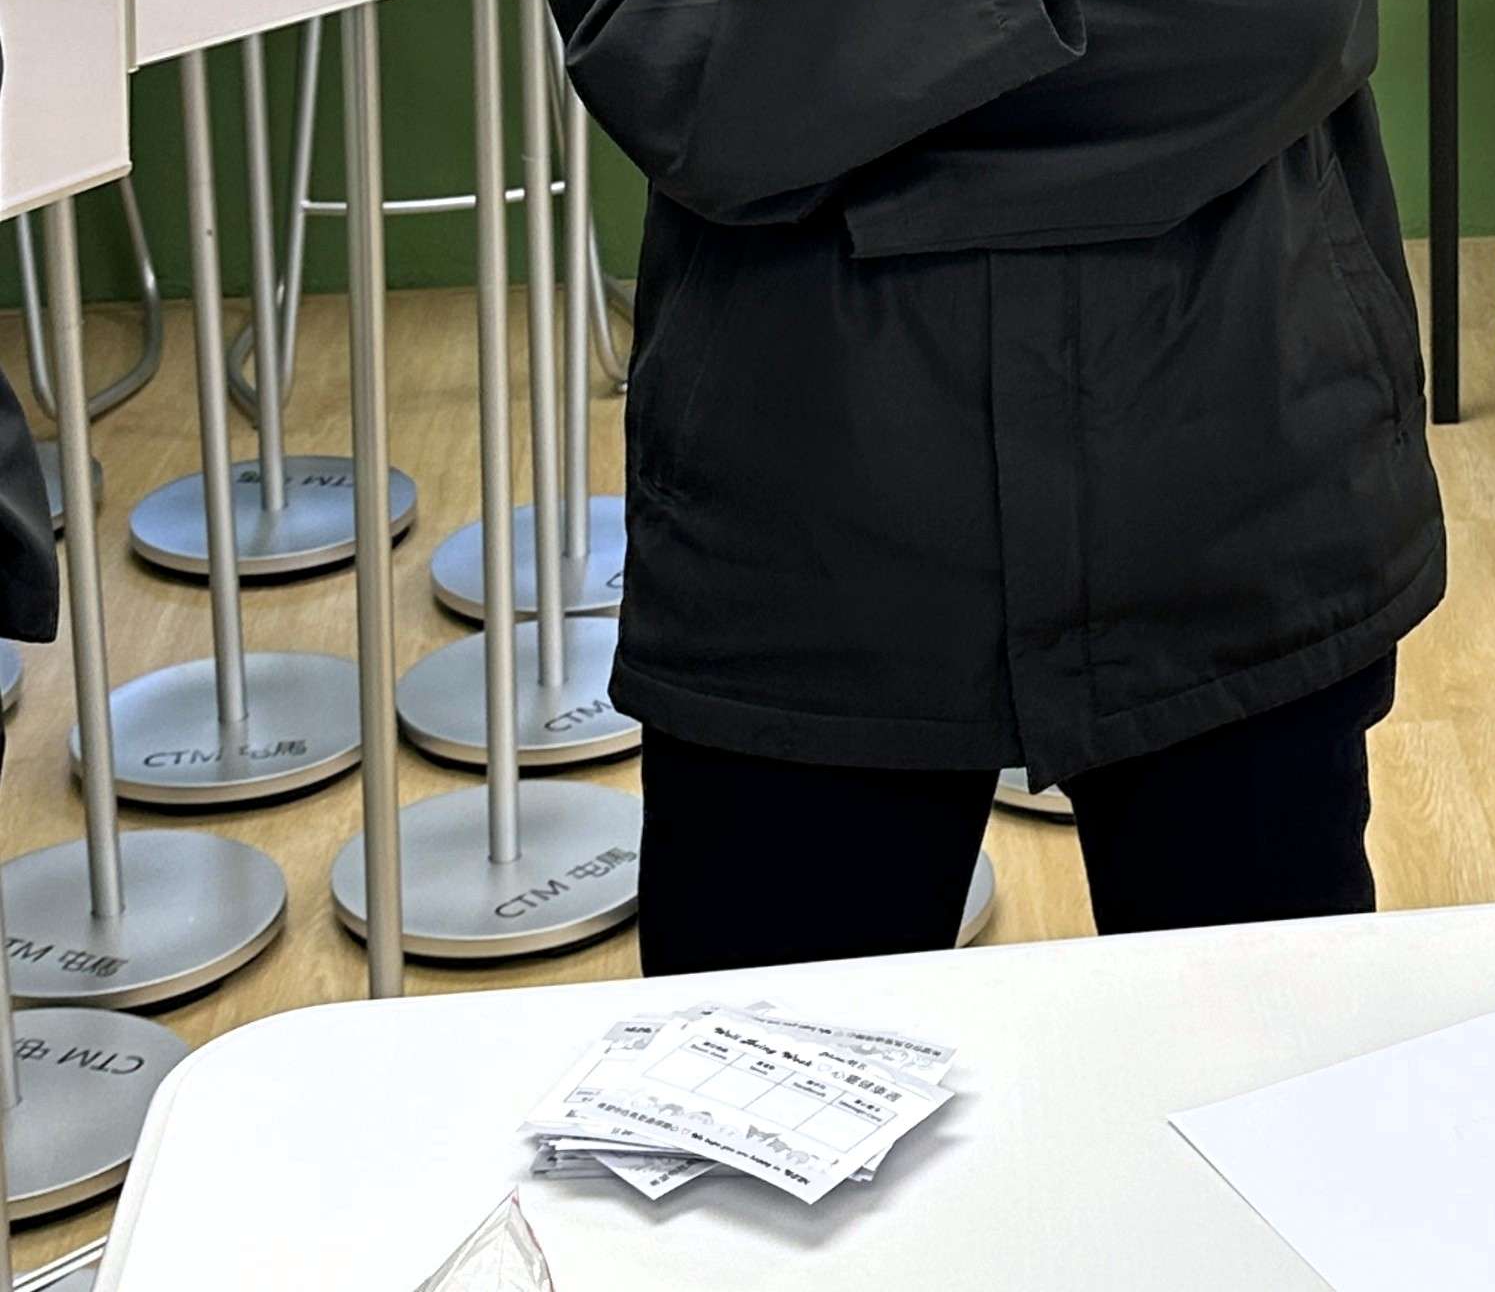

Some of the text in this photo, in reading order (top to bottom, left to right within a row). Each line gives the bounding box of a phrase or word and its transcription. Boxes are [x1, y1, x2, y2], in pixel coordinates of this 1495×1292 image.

[544, 699, 612, 733] CTM
[143, 745, 224, 768] CTM
[495, 877, 567, 919] CTM
[4, 937, 55, 963] TM
[56, 1046, 145, 1074] CTM
